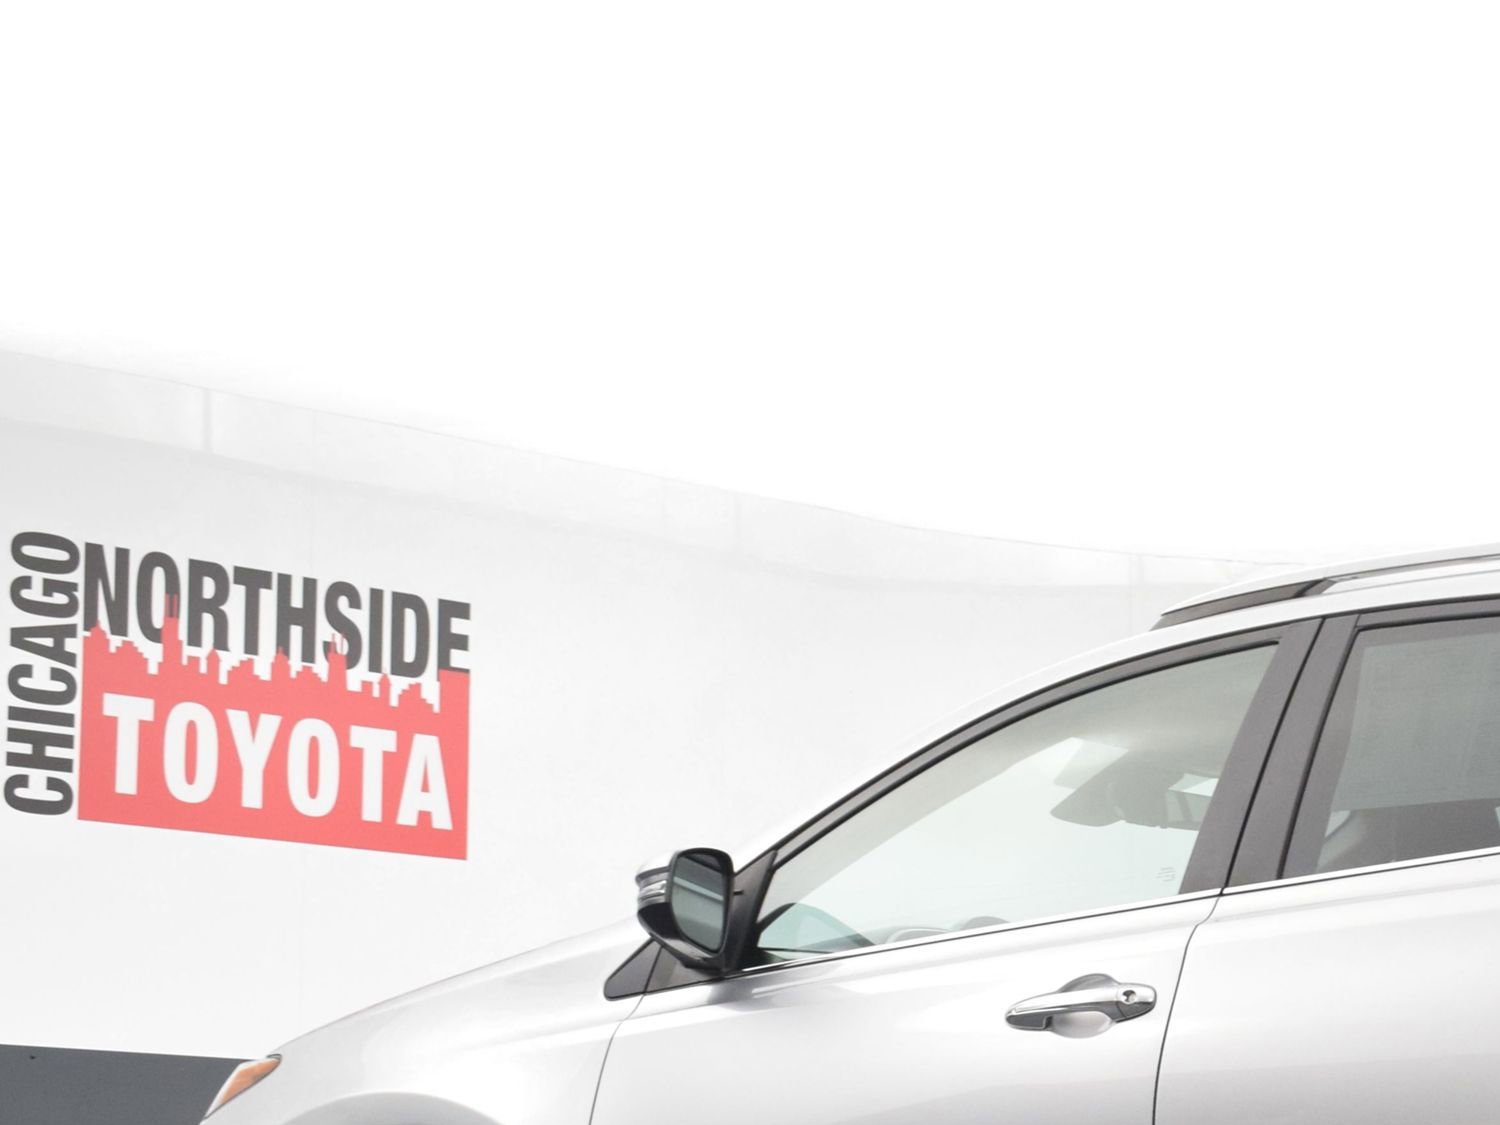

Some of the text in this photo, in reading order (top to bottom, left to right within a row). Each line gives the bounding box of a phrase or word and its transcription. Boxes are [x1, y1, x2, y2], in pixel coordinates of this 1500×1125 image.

[4, 531, 80, 816] CHICAGO
[83, 541, 471, 682] NORTHSIDE
[102, 692, 453, 830] TOYOTA
